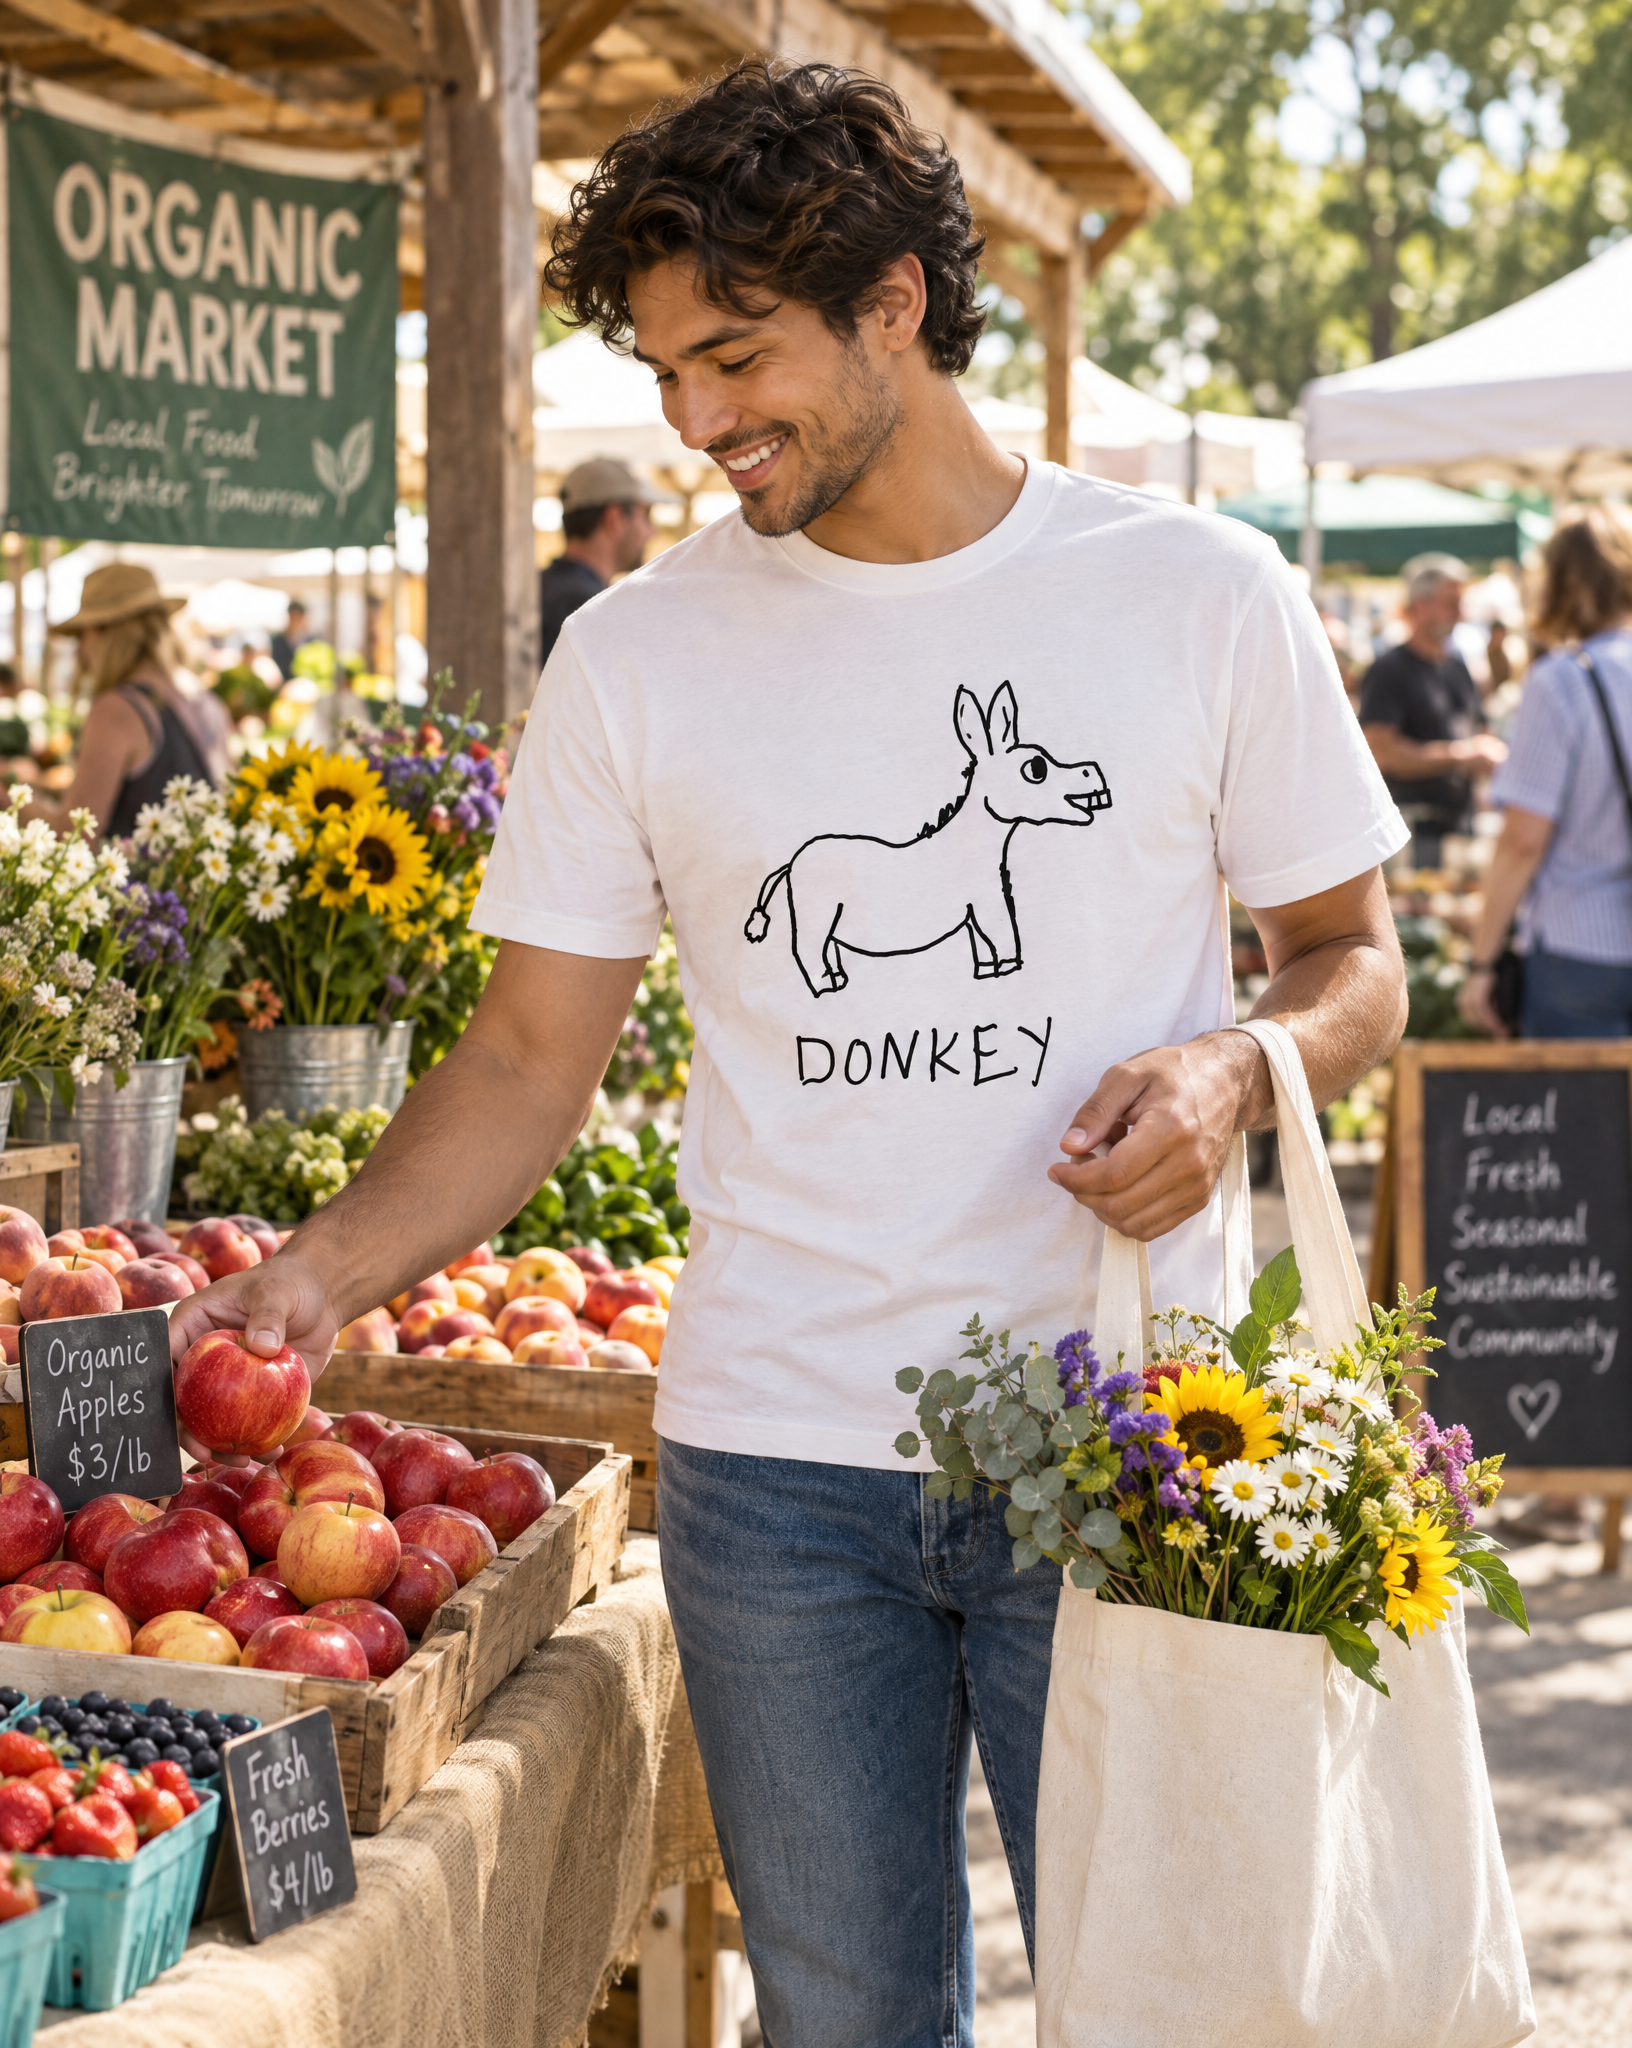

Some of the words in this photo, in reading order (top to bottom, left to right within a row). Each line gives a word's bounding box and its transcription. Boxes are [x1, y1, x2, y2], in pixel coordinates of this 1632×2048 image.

[53, 161, 363, 300] ORGANIC
[76, 276, 345, 399] MARKET
[82, 400, 170, 451] Local
[182, 410, 259, 461] Food
[52, 452, 190, 524] Brighter
[201, 467, 325, 518] Tomorrow
[796, 1016, 1053, 1087] DONKEY
[1462, 1088, 1558, 1137] Local
[1465, 1145, 1561, 1194] Fresh
[1450, 1201, 1588, 1249] Seasonal
[1443, 1256, 1618, 1303] Sustainable
[47, 1335, 149, 1388] Organic
[1447, 1313, 1619, 1375] Community
[57, 1380, 145, 1437] Apples
[68, 1435, 151, 1487] $3/lb
[246, 1736, 310, 1801] Fresh
[250, 1799, 330, 1855] Berries
[268, 1850, 334, 1914] $4/lb
